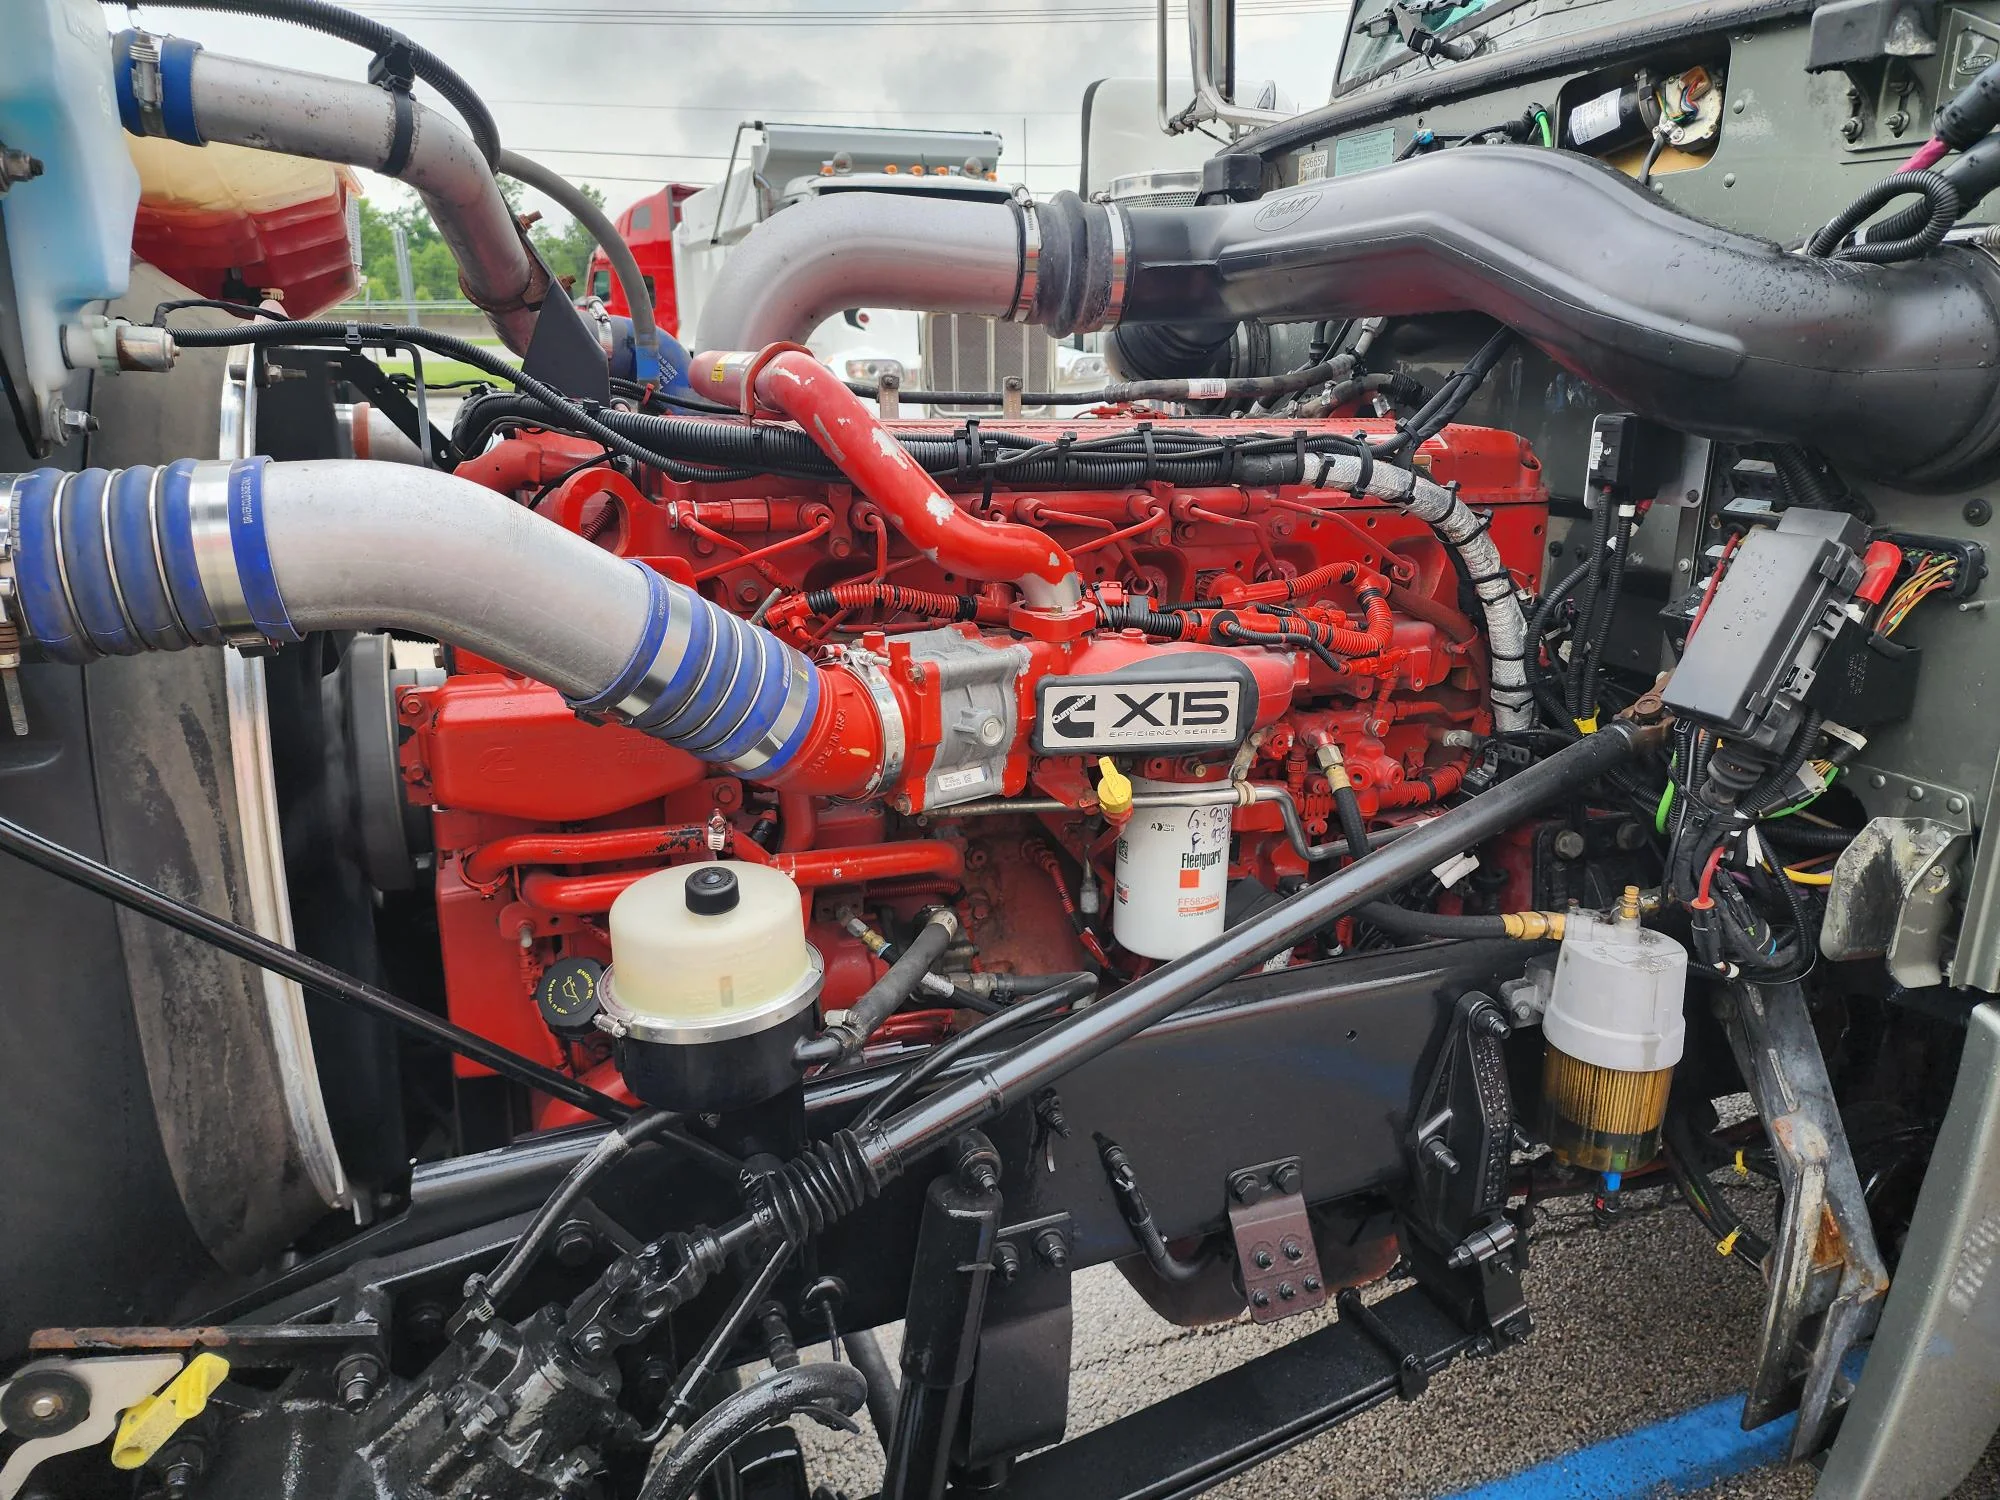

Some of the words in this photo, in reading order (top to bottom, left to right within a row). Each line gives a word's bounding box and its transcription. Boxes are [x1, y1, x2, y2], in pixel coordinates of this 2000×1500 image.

[1052, 694, 1093, 725] Cummins
[1111, 690, 1230, 728] X15
[1109, 729, 1181, 738] EFFICIENCY
[1181, 848, 1223, 870] Fleetguard
